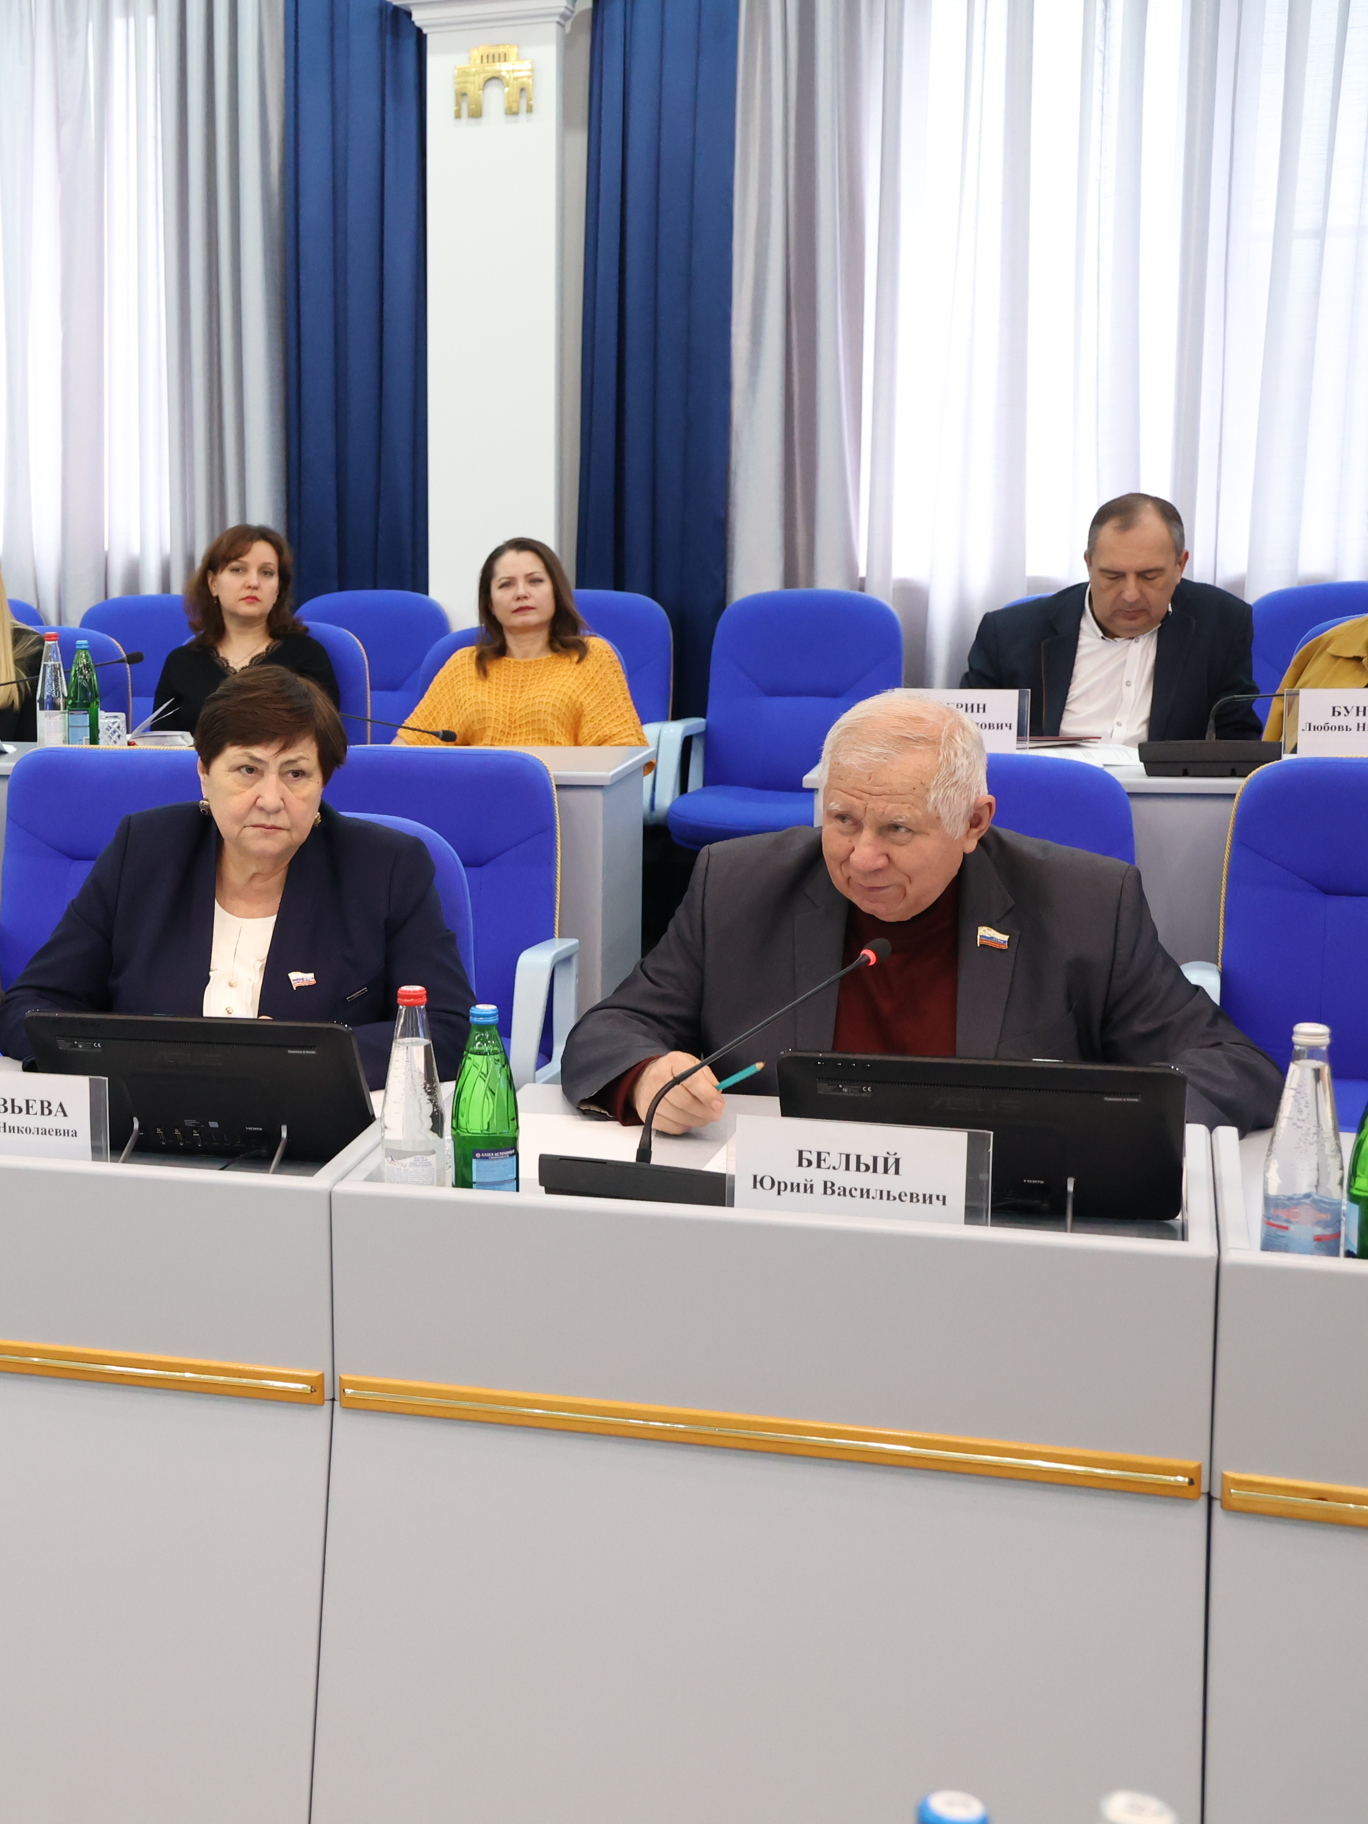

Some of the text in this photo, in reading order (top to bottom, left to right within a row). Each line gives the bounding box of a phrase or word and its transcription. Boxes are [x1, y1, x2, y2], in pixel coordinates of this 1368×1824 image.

[975, 722, 1013, 731] ович
[1301, 722, 1352, 732] Любовь
[795, 1149, 903, 1176] БЕЛЫЙ
[751, 1174, 948, 1206] Юрий Васильевич
